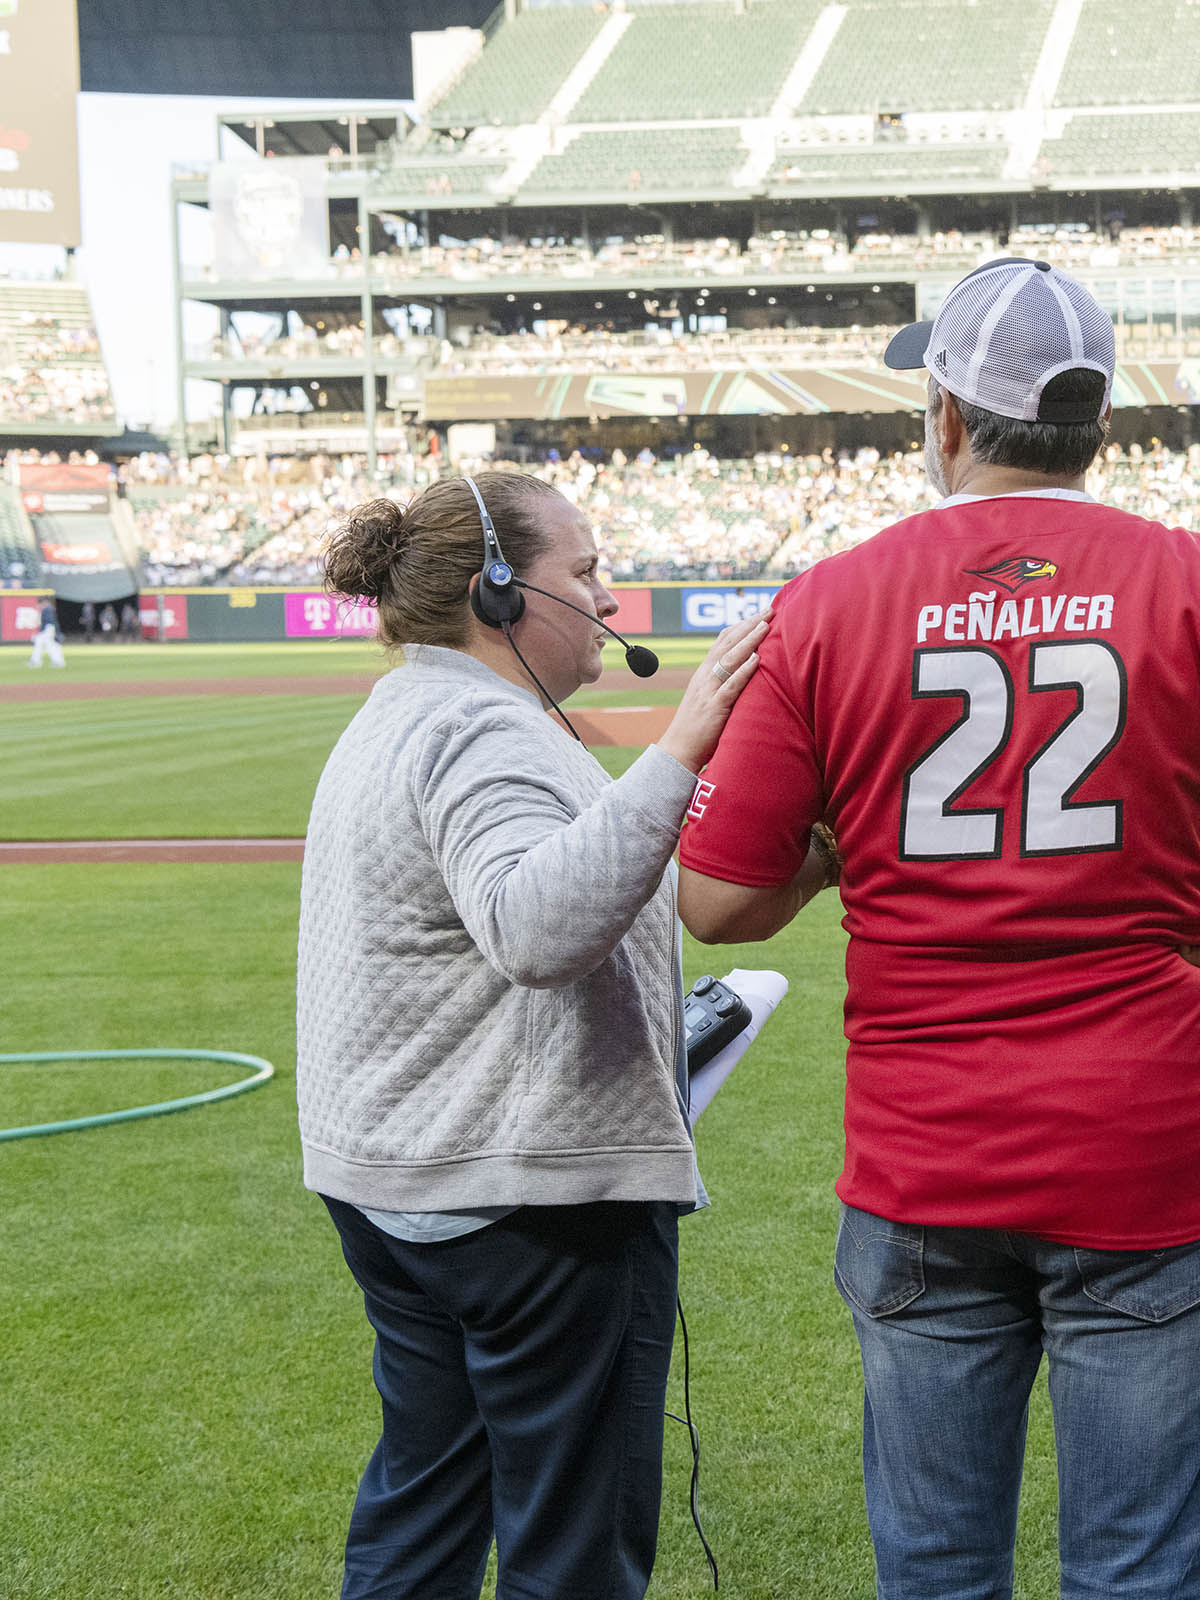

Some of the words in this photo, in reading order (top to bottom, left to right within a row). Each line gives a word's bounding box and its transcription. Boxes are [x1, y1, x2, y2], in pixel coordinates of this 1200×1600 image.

[304, 598, 331, 630] T
[917, 591, 1114, 643] PEÑALVER
[899, 637, 1128, 862] 22
